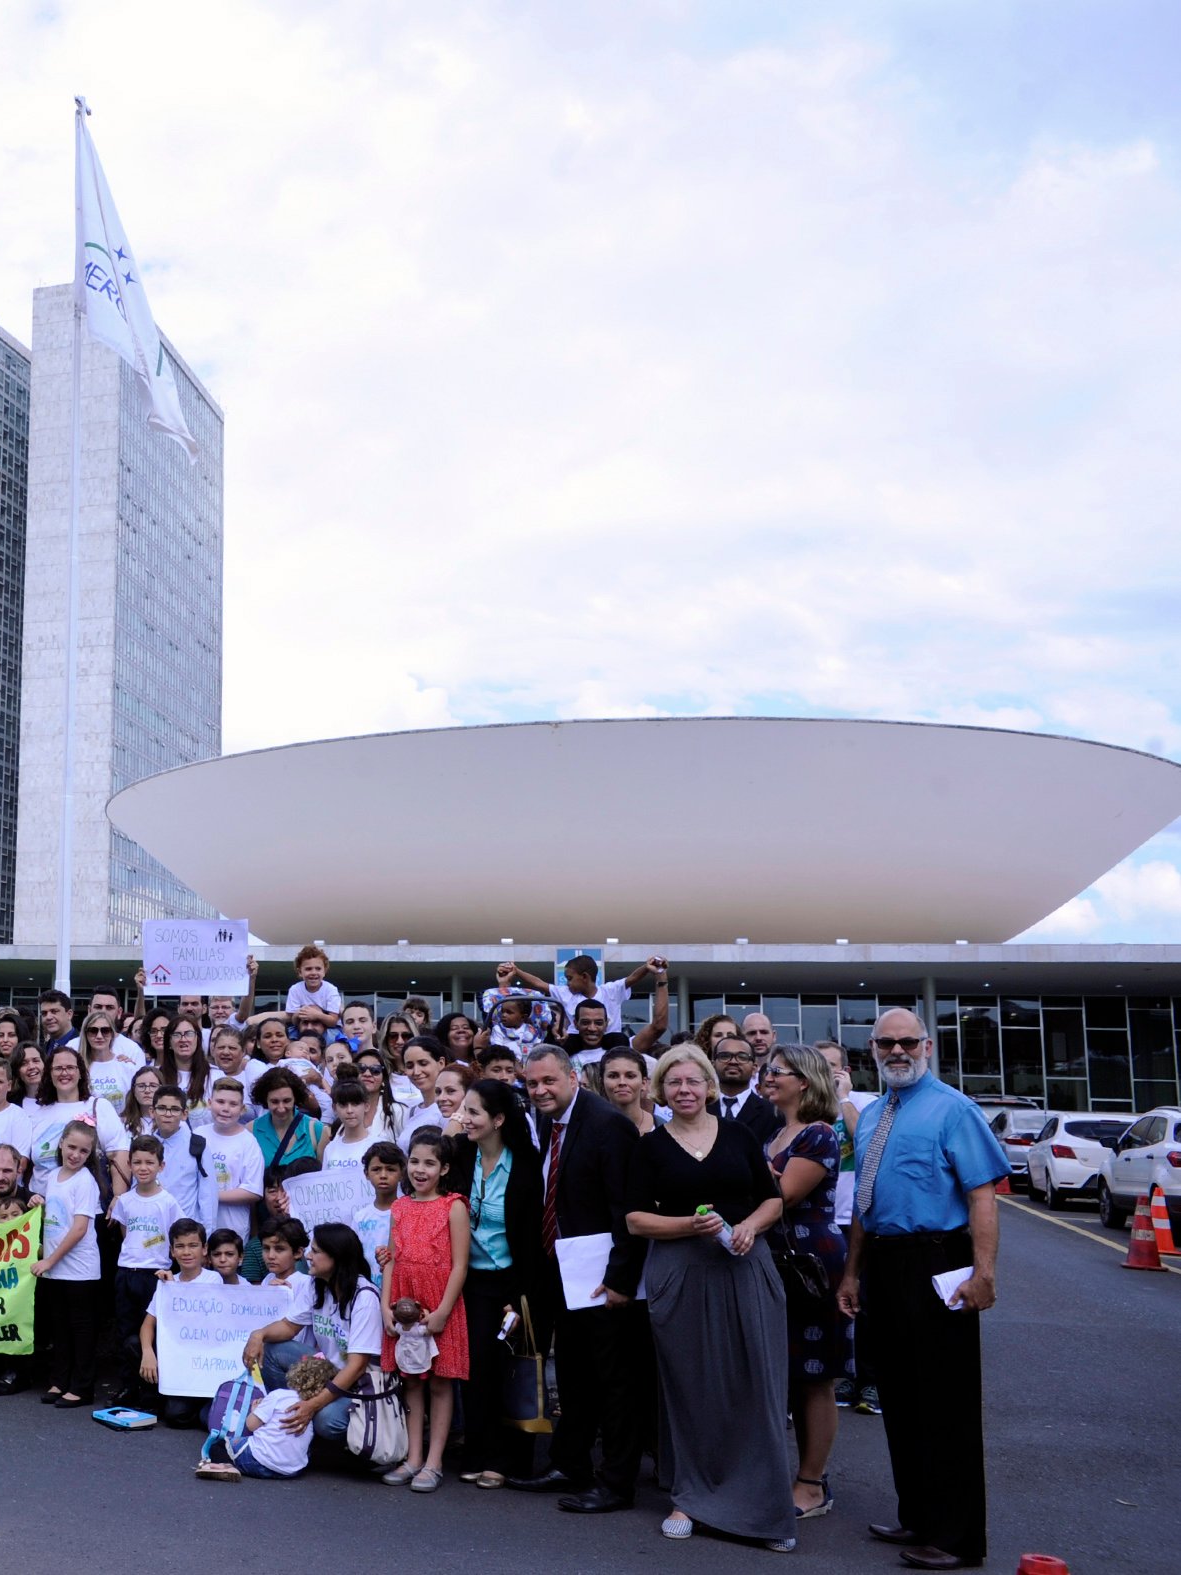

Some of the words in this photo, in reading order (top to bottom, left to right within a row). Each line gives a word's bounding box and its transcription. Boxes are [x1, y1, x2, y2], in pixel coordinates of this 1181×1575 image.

[154, 928, 198, 943] SOMOS
[171, 945, 225, 961] FAMÍLIAS
[179, 965, 246, 982] EDUCADORAS
[294, 1180, 354, 1206] CUMPRIMOS
[172, 1297, 223, 1317] EDUCAÇÃO
[231, 1303, 279, 1316] DOMICILIAR
[179, 1326, 209, 1341] QUEM
[214, 1328, 248, 1343] CONHE
[202, 1356, 238, 1371] APROVA
